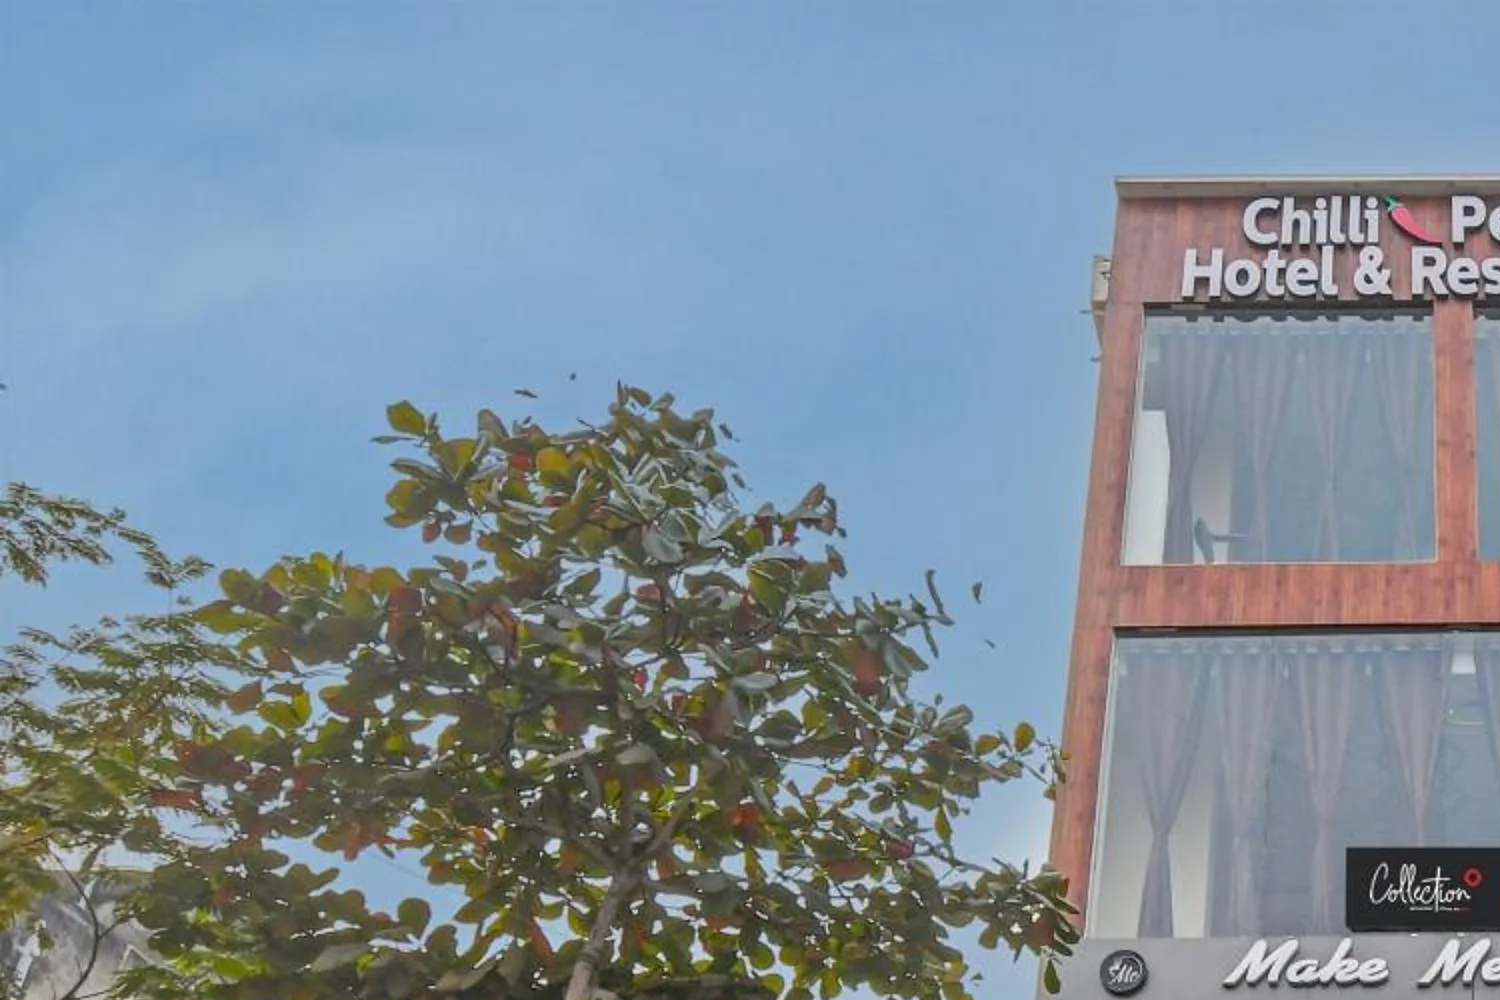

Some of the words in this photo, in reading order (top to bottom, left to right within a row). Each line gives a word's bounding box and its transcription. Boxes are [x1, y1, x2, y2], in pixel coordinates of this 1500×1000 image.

[1241, 196, 1380, 247] Chilli
[1181, 246, 1337, 299] Hotel
[1352, 247, 1392, 296] &
[1369, 862, 1472, 912] Collection
[1222, 937, 1391, 987] Make
